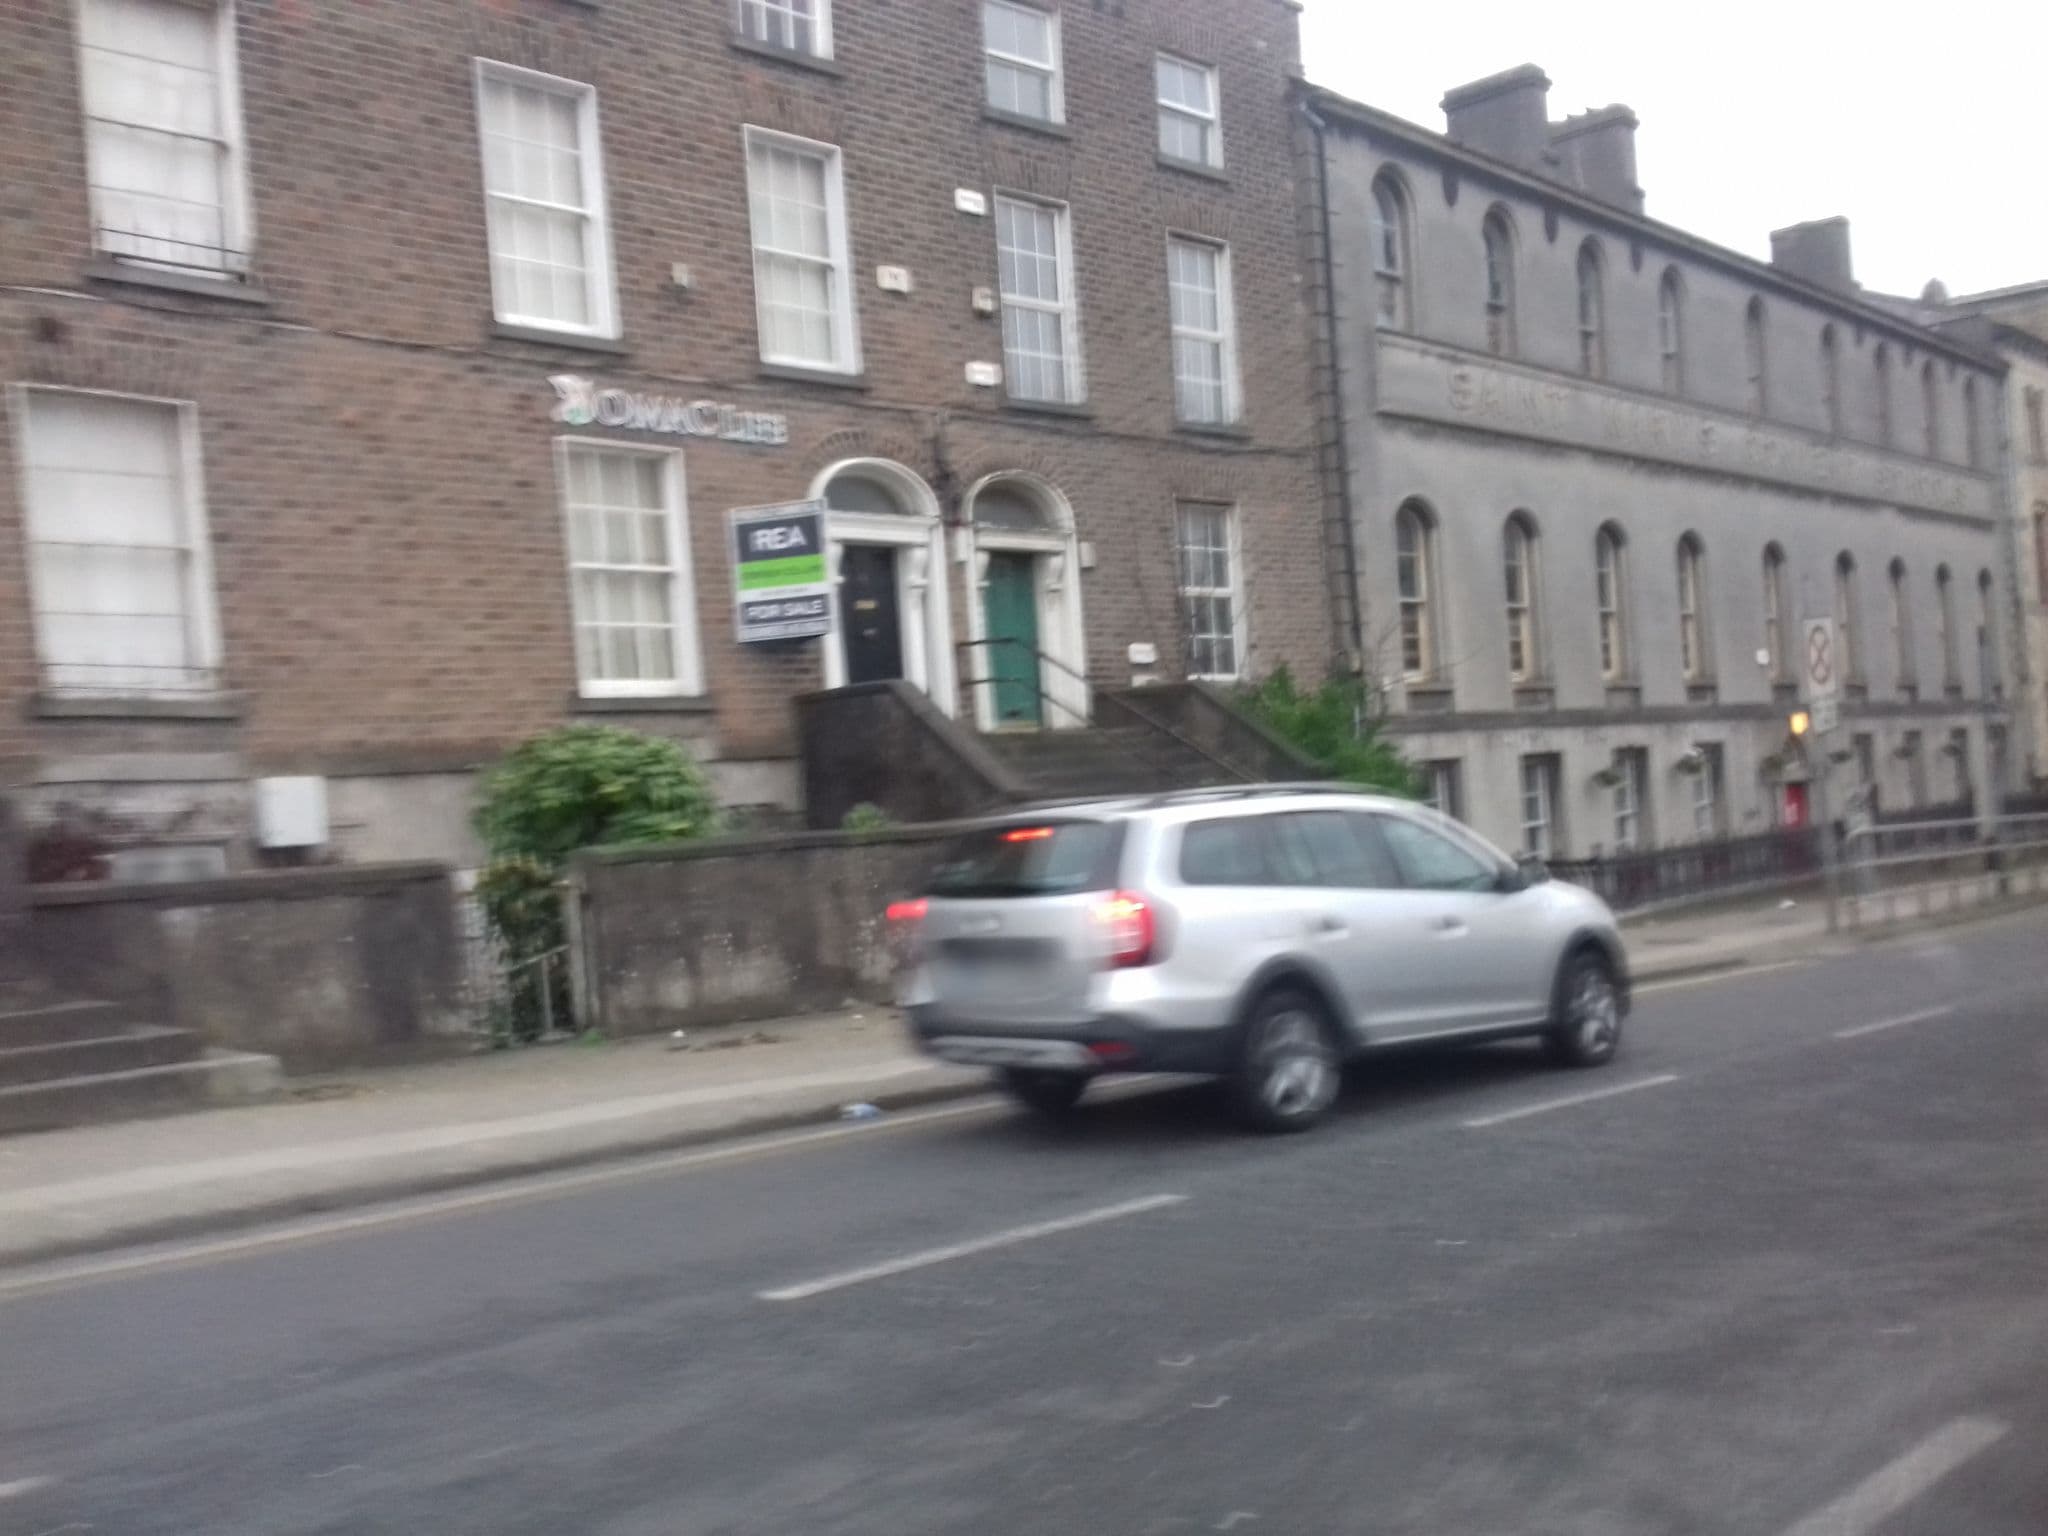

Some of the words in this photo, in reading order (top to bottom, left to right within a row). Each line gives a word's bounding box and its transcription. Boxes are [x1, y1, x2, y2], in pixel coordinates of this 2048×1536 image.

[751, 526, 806, 549] REA
[747, 604, 780, 619] FOR
[783, 600, 823, 616] SALE
